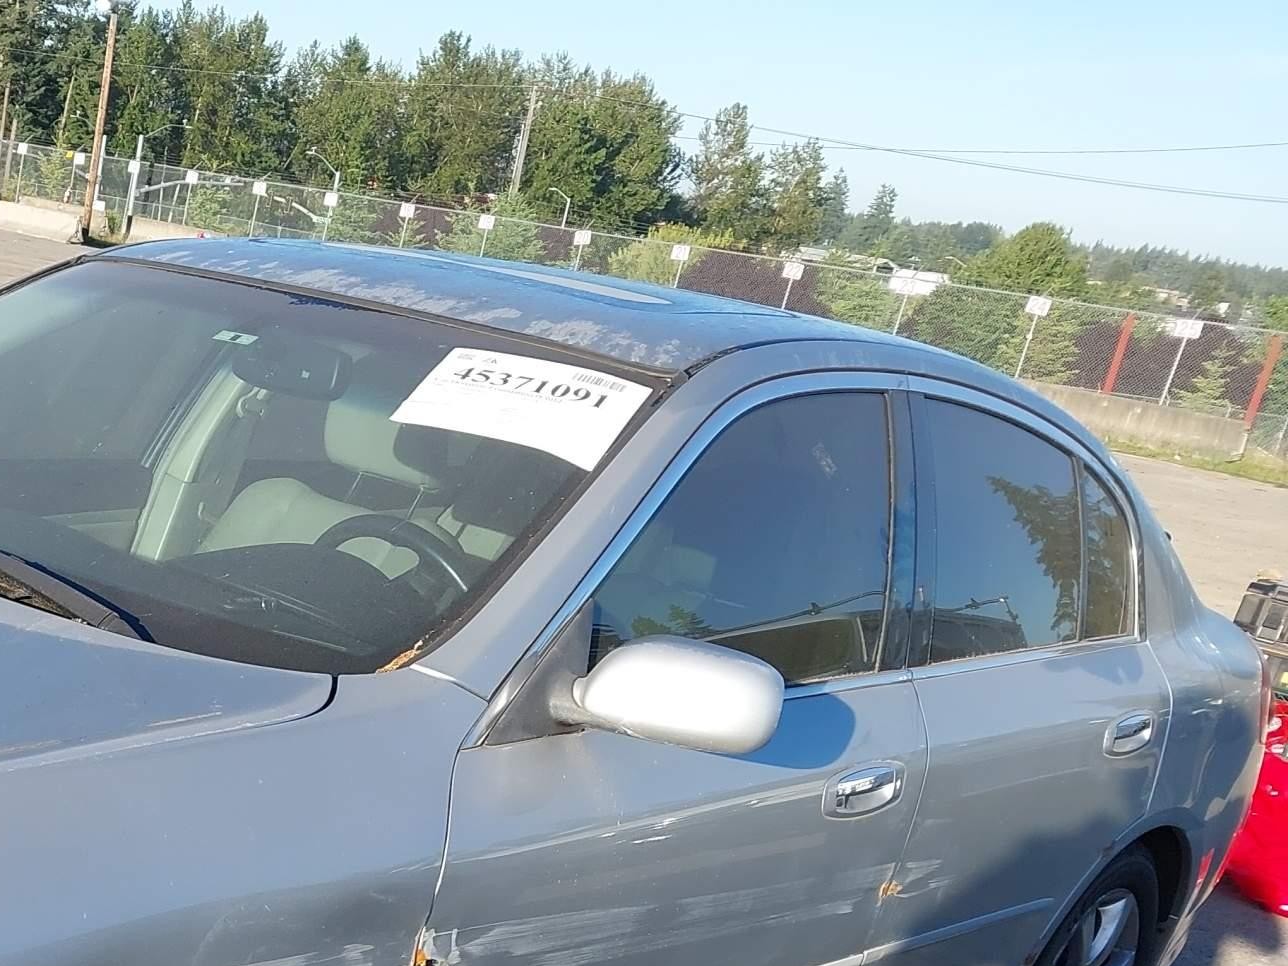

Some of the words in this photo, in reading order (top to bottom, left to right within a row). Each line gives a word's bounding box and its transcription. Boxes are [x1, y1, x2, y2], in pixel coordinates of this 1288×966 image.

[576, 231, 589, 244] 20
[675, 246, 687, 259] 21
[784, 263, 801, 279] 22
[1030, 297, 1048, 313] 24
[1179, 320, 1200, 336] 25
[453, 367, 608, 408] 45371091
